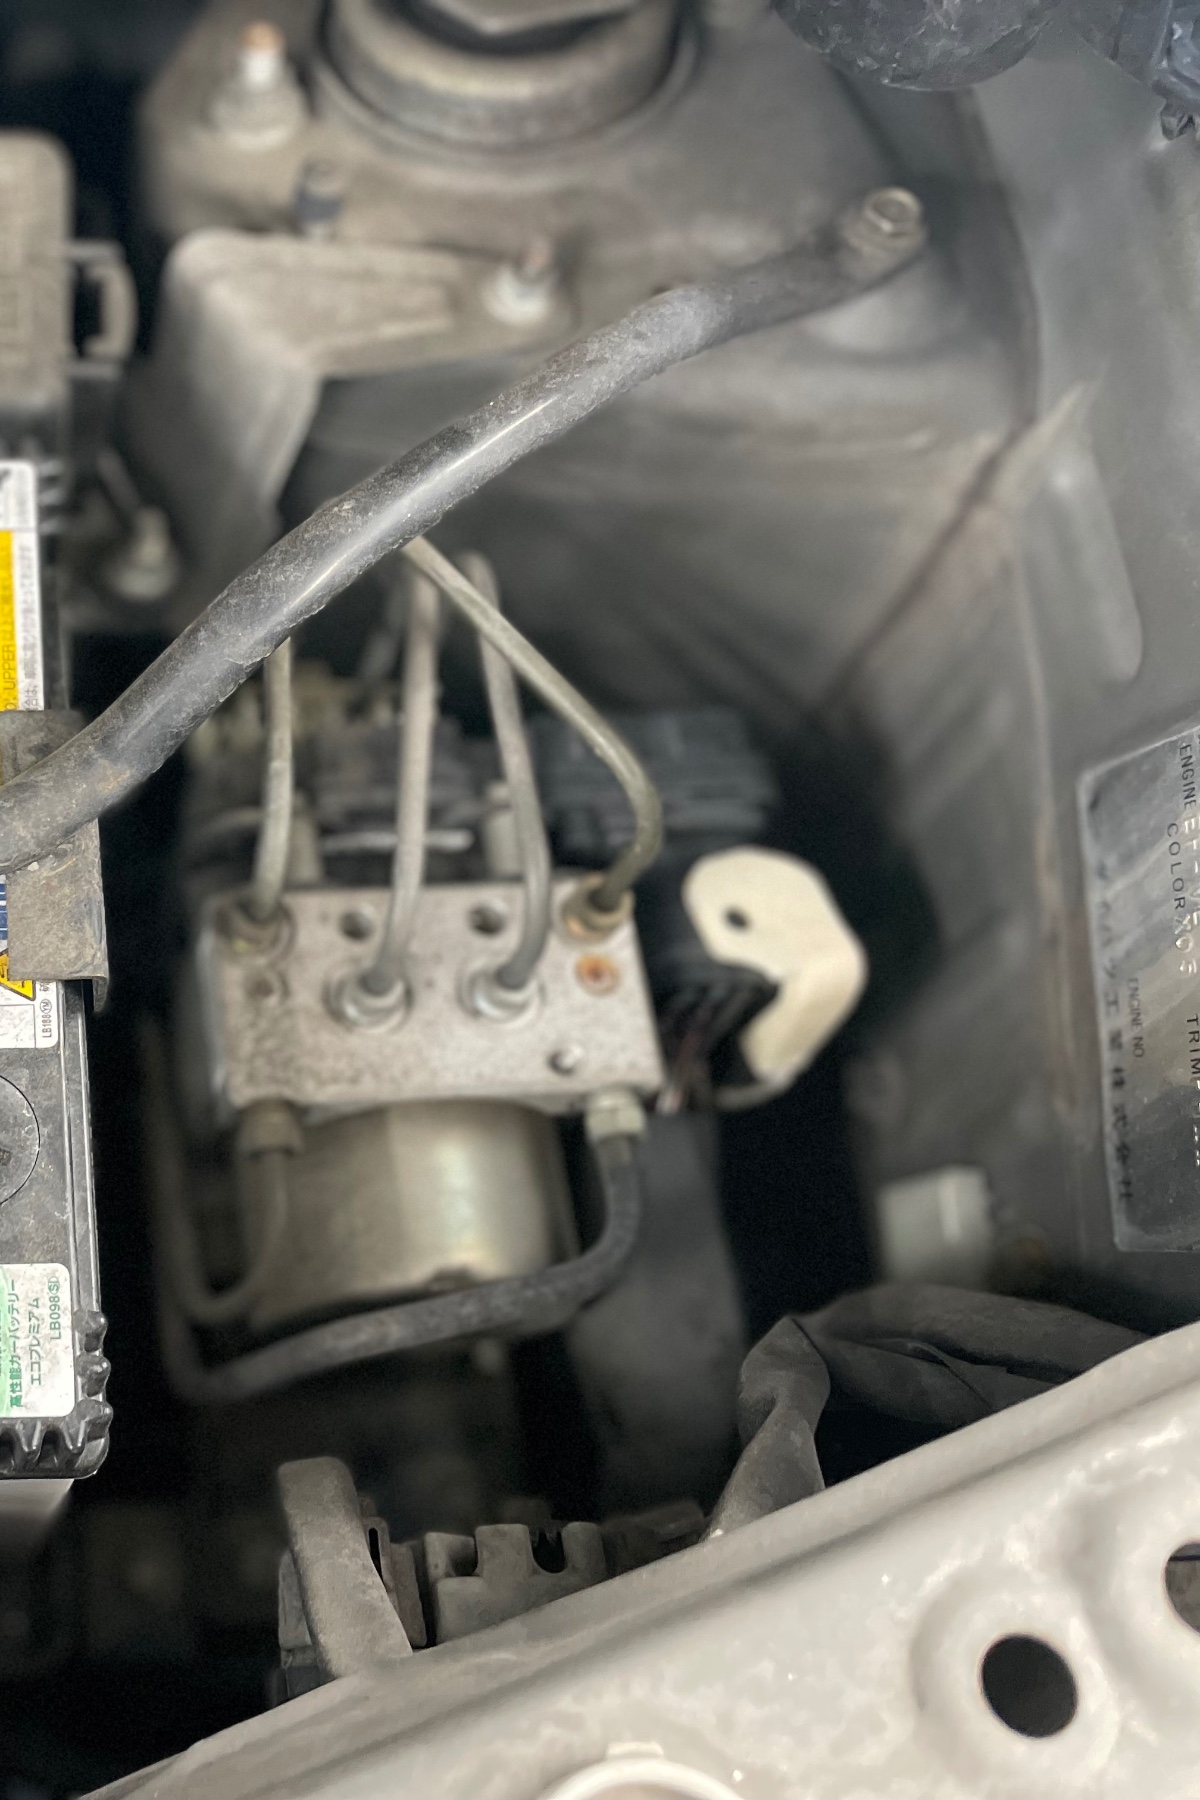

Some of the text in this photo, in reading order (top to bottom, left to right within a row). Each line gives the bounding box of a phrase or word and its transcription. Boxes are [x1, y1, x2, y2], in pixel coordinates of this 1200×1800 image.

[1179, 744, 1197, 811] ENGINE
[1166, 823, 1186, 910] COLOR
[1127, 977, 1143, 1032] ENGINE
[1186, 1014, 1200, 1075] TRIM
[8, 1279, 23, 1408] 高性能カーバッテリー
[27, 1298, 42, 1386] エコプレミアム
